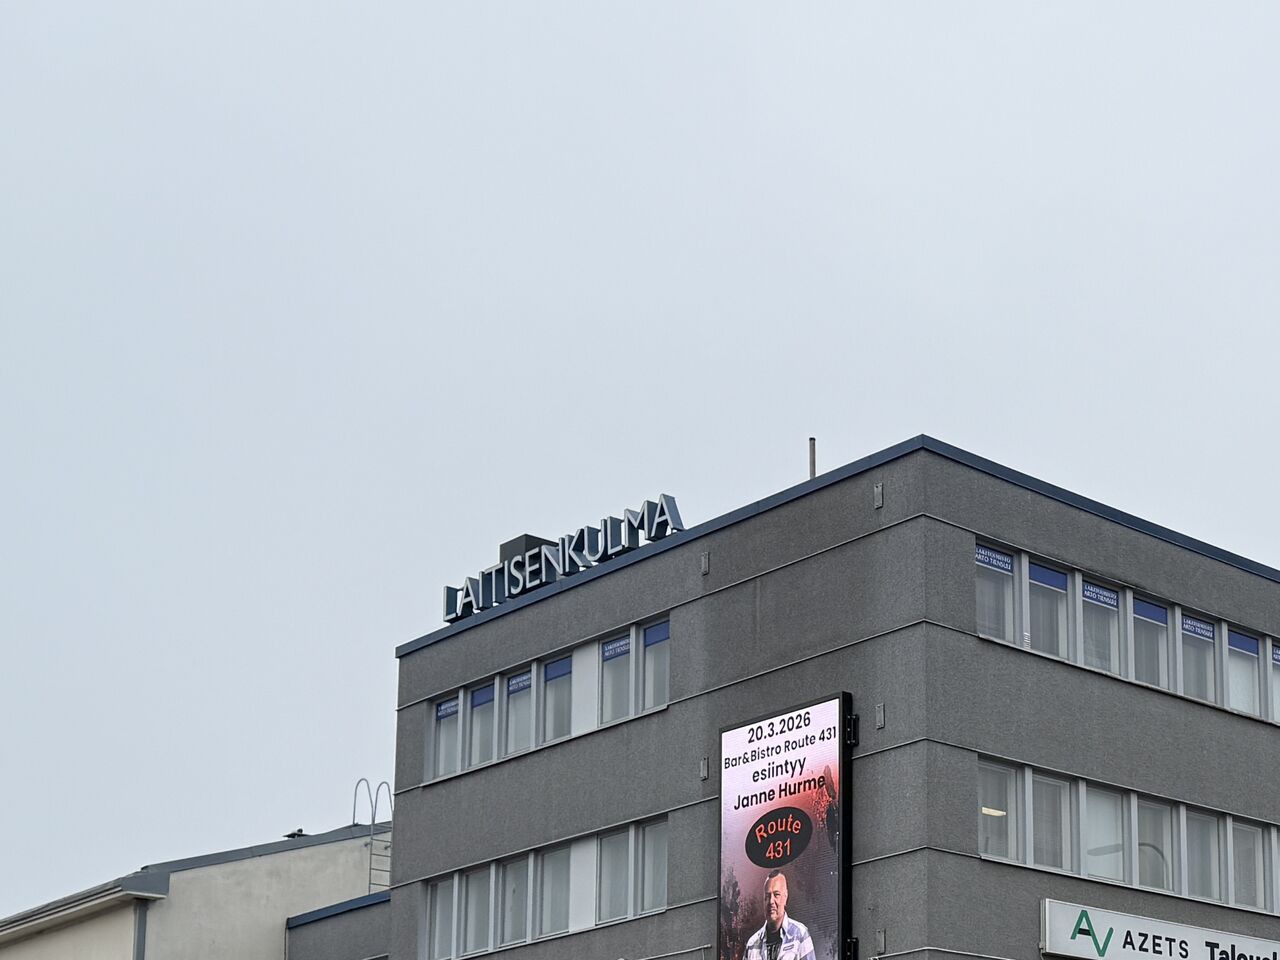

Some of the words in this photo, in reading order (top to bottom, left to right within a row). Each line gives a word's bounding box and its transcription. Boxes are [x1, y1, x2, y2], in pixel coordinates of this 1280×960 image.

[443, 493, 684, 623] LAITISENKULMA
[748, 711, 811, 744] 20.3.2026
[724, 744, 782, 770] Bar&Bistro
[784, 734, 816, 753] Route
[819, 726, 837, 742] 431
[752, 757, 806, 783] esiintyy
[734, 787, 776, 811] Janne
[778, 775, 826, 799] Hurme
[755, 813, 802, 844] Route
[765, 838, 791, 860] 431
[1122, 930, 1189, 959] AZETS
